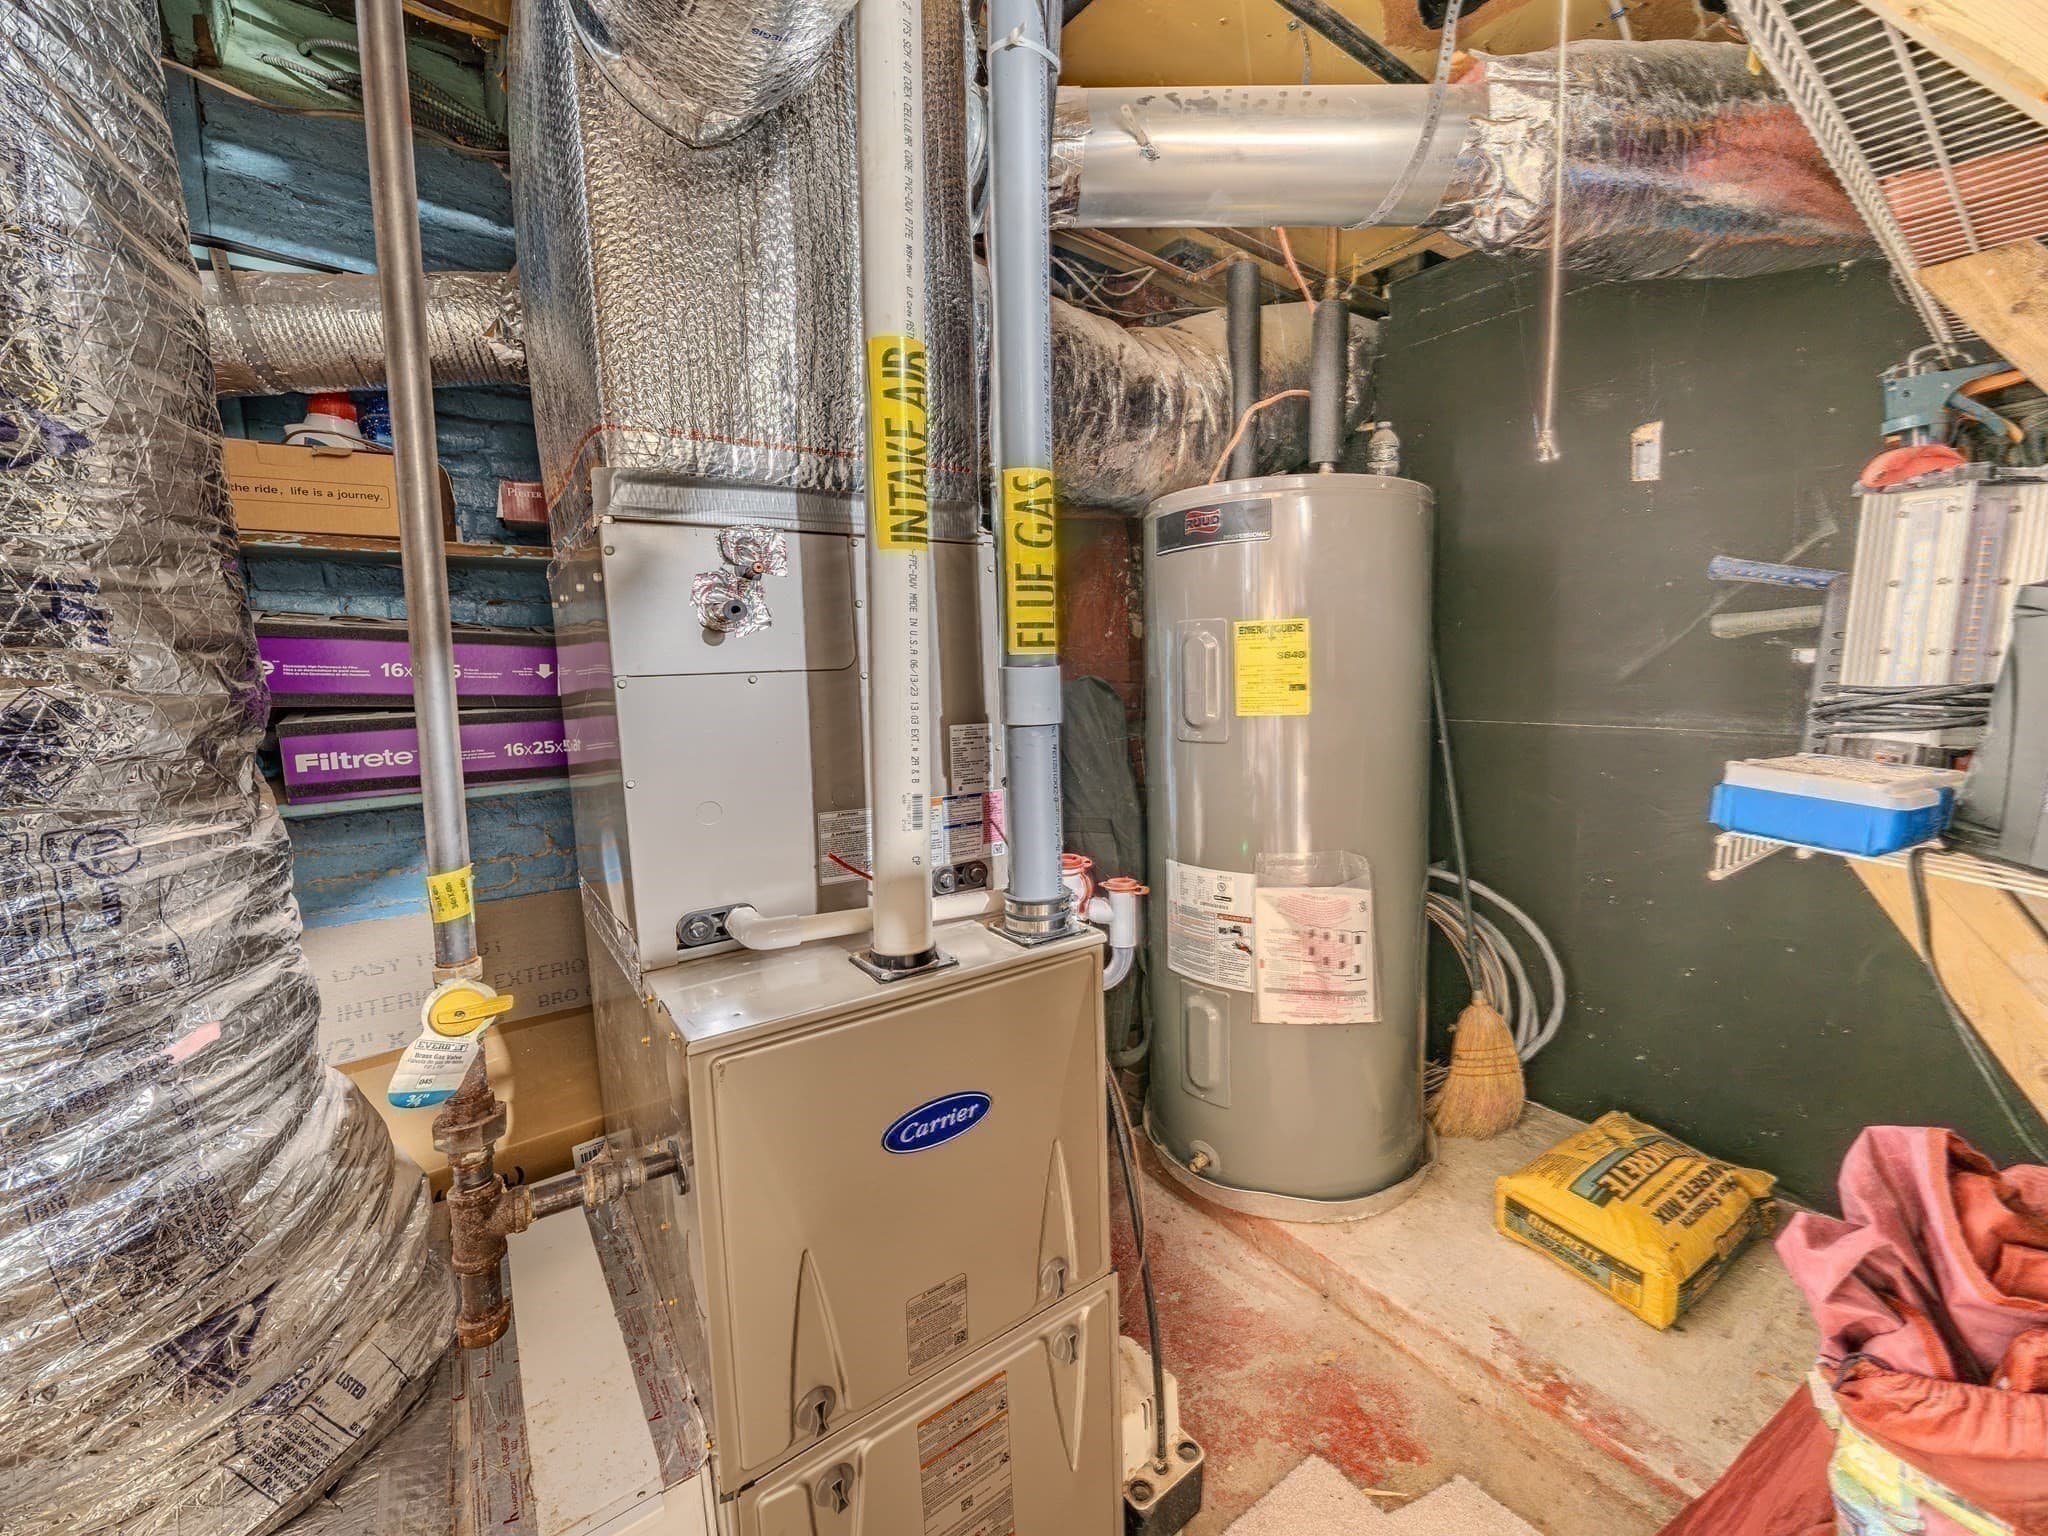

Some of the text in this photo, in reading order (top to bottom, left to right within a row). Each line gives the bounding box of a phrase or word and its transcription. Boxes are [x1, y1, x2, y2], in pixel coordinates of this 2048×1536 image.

[902, 18, 912, 37] IPS
[902, 38, 912, 58] SCH
[903, 61, 912, 73] 40
[903, 76, 913, 100] COEX
[903, 102, 913, 147] CELLULAR
[903, 149, 913, 173] CORE
[904, 217, 914, 241] PIPE
[882, 347, 928, 544] INTAKE AIR
[290, 487, 309, 497] life
[313, 488, 323, 497] is
[327, 490, 334, 498] a
[337, 490, 384, 502] journey.
[1186, 515, 1219, 529] RUUD
[1013, 475, 1056, 649] FLUE GAS
[908, 593, 918, 613] MADE
[909, 617, 918, 627] IN
[909, 659, 919, 697] 06/13/23
[295, 749, 414, 773] Filtrete
[911, 756, 920, 766] 2A
[911, 856, 920, 865] CP
[494, 957, 586, 991] EXTERIO
[336, 990, 428, 1023] INTERI
[414, 1052, 432, 1060] Brass
[900, 1103, 979, 1143] Carrier
[1653, 1203, 1686, 1225] MIX
[335, 1370, 368, 1402] LISTED
